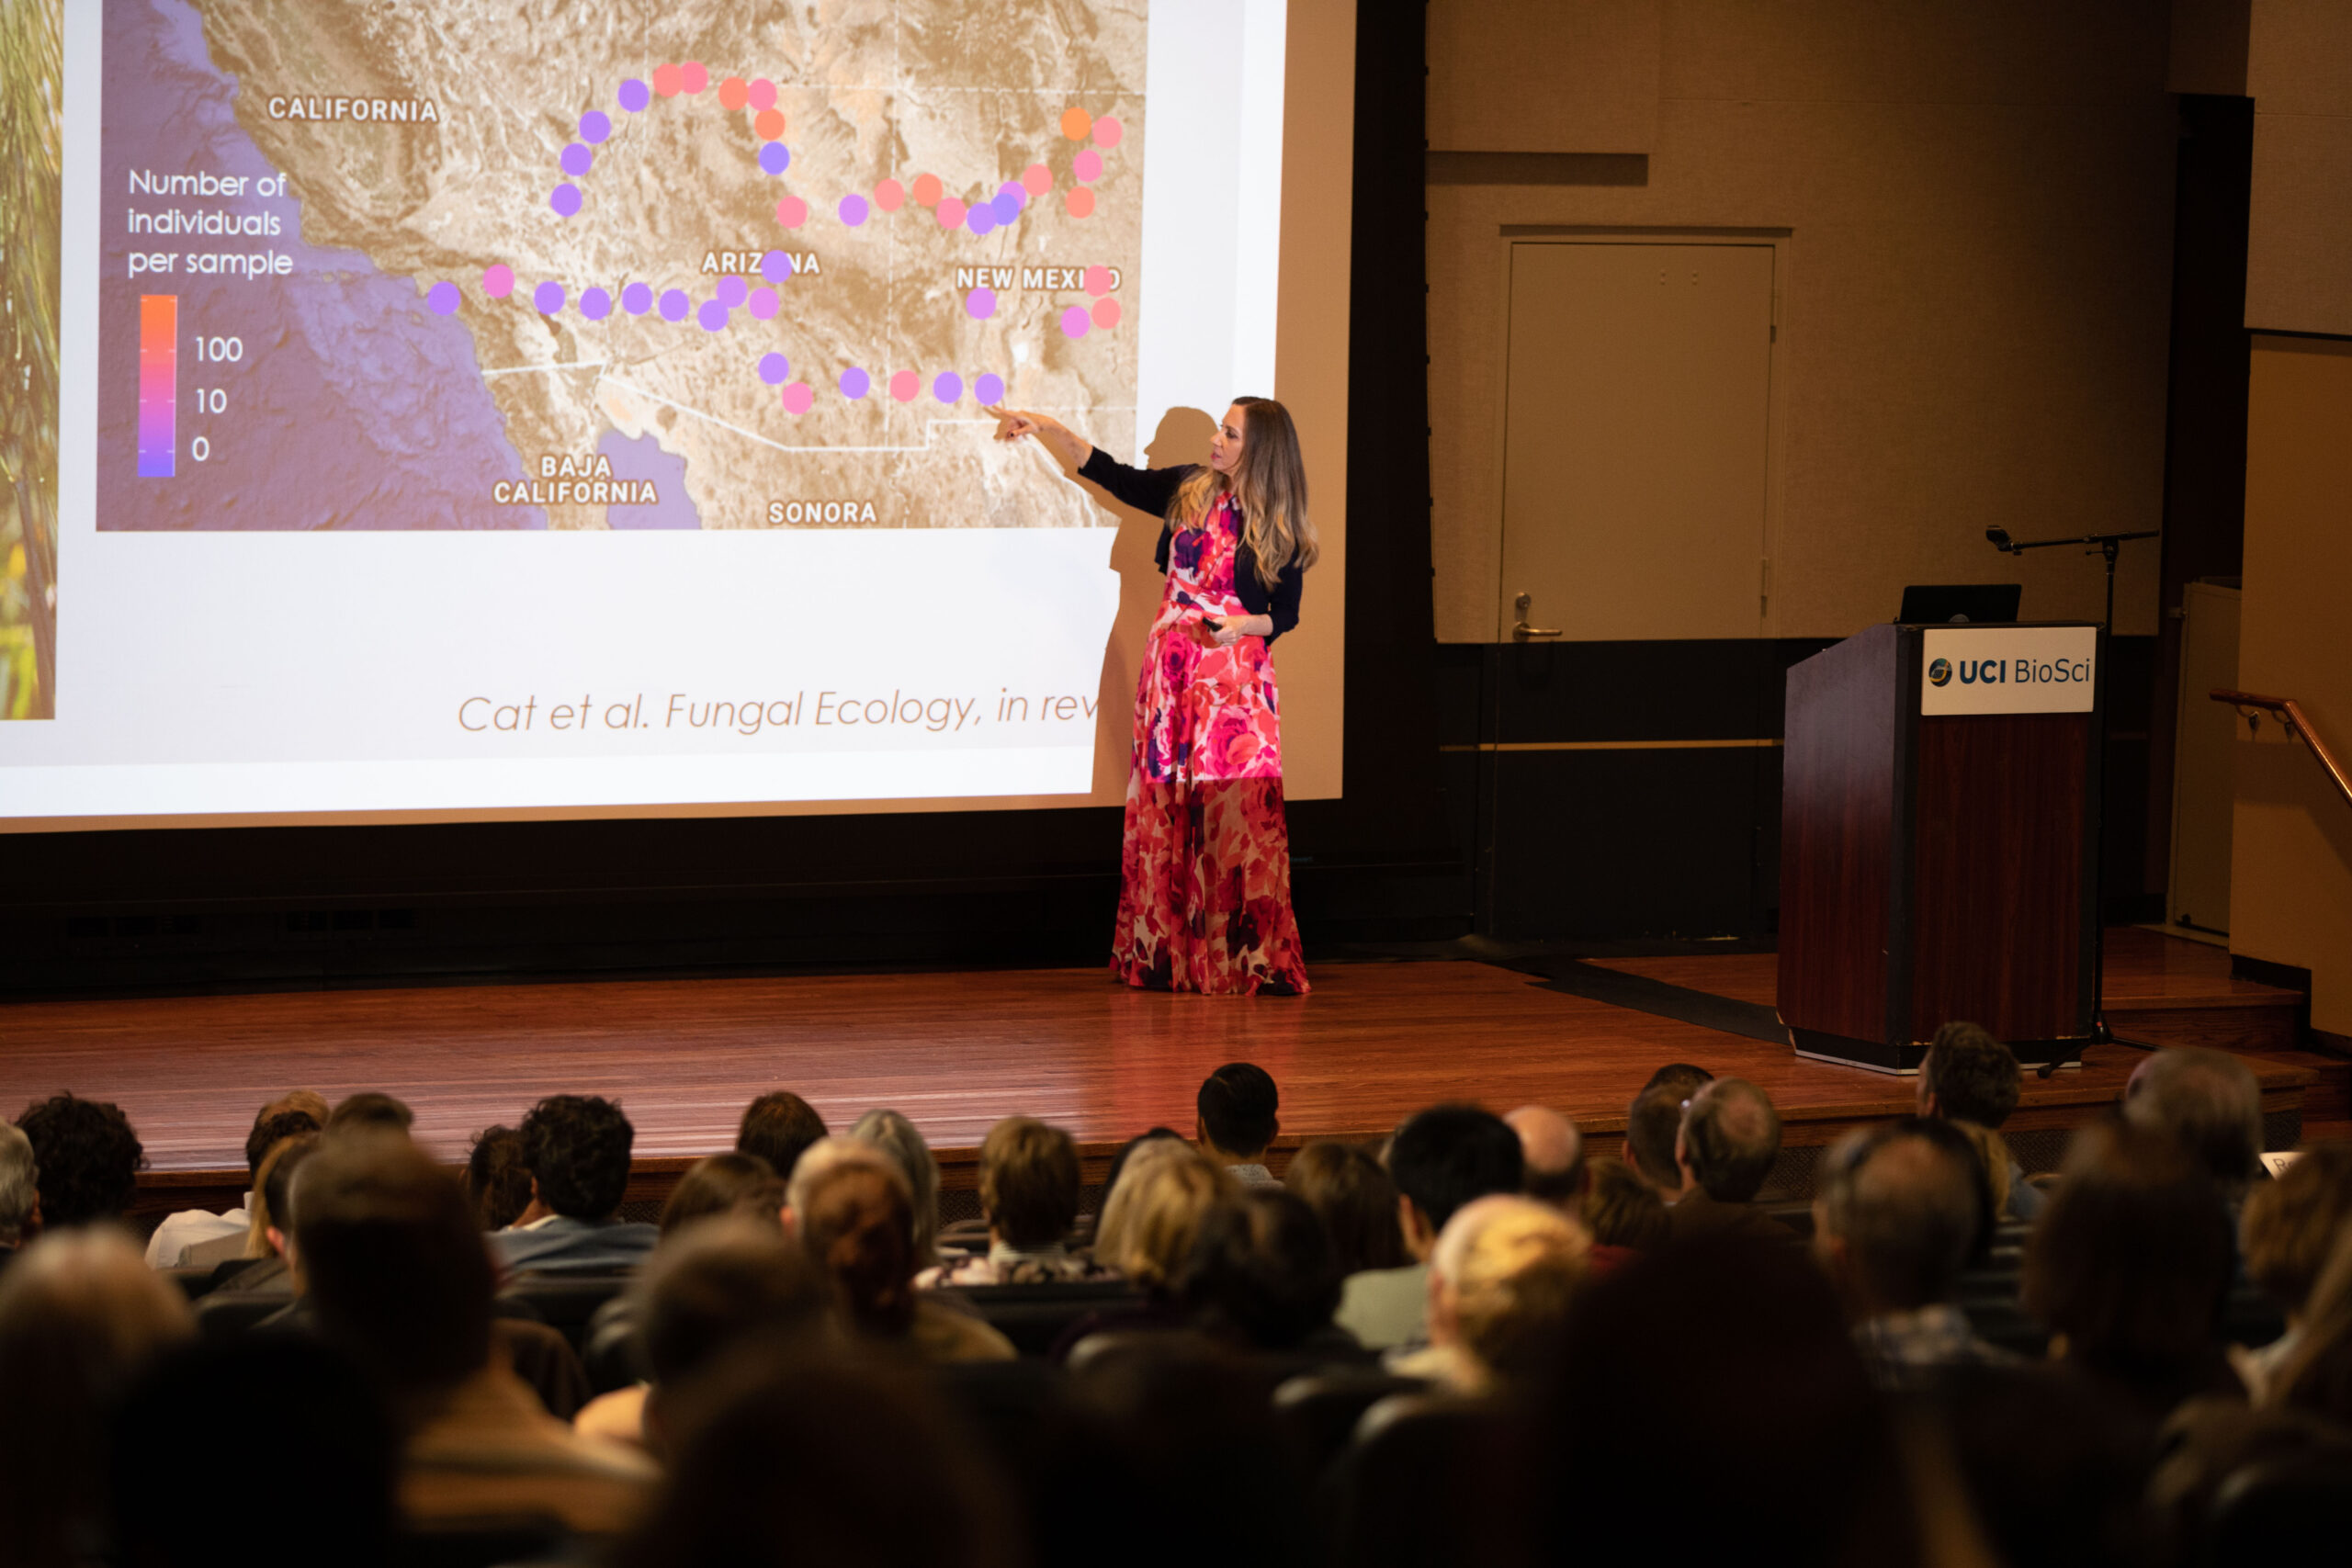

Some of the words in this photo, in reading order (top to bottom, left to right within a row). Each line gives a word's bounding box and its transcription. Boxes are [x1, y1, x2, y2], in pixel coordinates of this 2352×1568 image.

[268, 96, 438, 122] CALIFORNIA
[129, 169, 249, 196] Number
[256, 172, 287, 197] of
[128, 208, 281, 235] individuals
[129, 252, 178, 279] per
[186, 250, 293, 280] sample
[702, 252, 820, 275] ARIZNA
[956, 268, 1013, 288] NEW
[1023, 268, 1120, 290] MEXI
[196, 336, 243, 362] 100
[196, 389, 227, 413] 10
[191, 436, 209, 461] 0
[541, 456, 612, 478] BAJA
[493, 482, 658, 503] CALIFORNIA
[768, 502, 876, 524] SONORA
[1959, 660, 2007, 684] UCI
[2015, 658, 2090, 682] BioSci
[458, 694, 537, 731] Cat
[550, 694, 592, 729] et
[605, 693, 649, 728] al.
[666, 691, 803, 735] Fungal
[816, 689, 981, 732] Ecology,
[998, 687, 1028, 722] in
